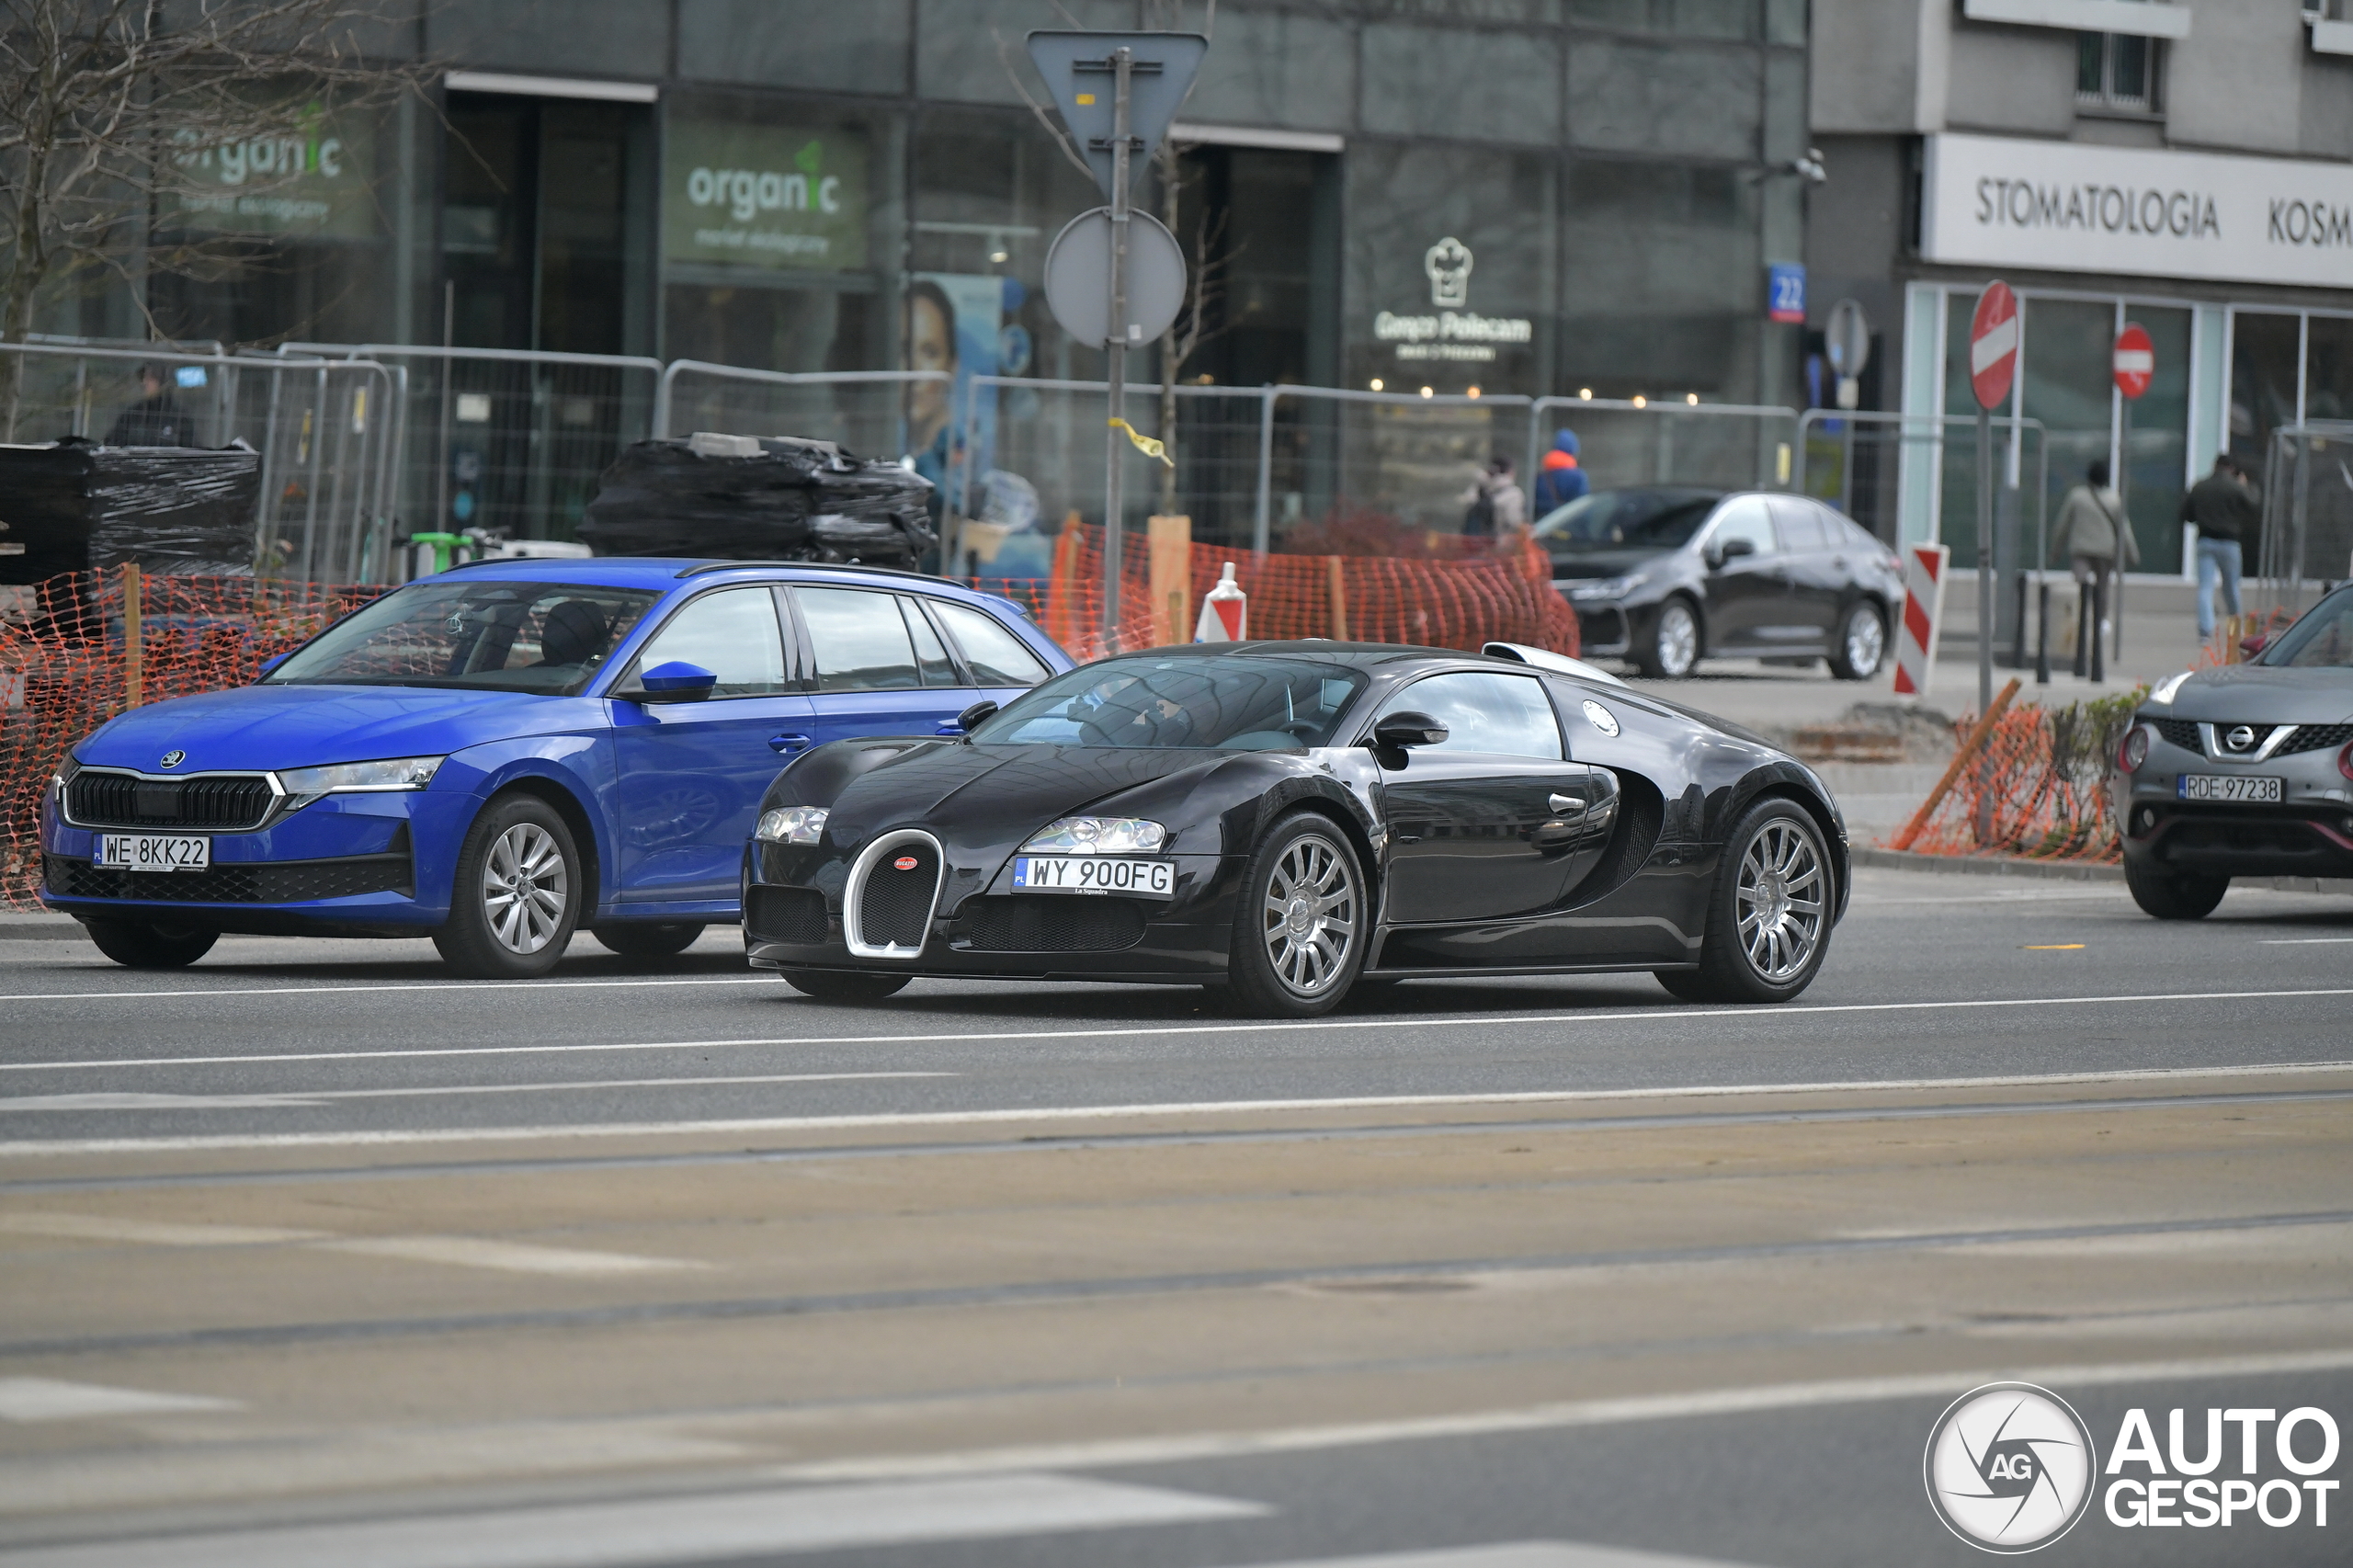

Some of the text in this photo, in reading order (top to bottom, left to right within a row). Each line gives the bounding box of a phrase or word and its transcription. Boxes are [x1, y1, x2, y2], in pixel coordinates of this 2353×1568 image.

[172, 102, 342, 184] organic
[688, 141, 840, 222] organic
[1974, 176, 2353, 250] STOMATOLOGIA KOSM
[1777, 277, 1803, 311] 22
[1439, 311, 1532, 343] Polecam
[2188, 778, 2279, 800] RDE 97238
[107, 837, 204, 865] WE 8KK22
[1033, 860, 1168, 892] WY 900FG
